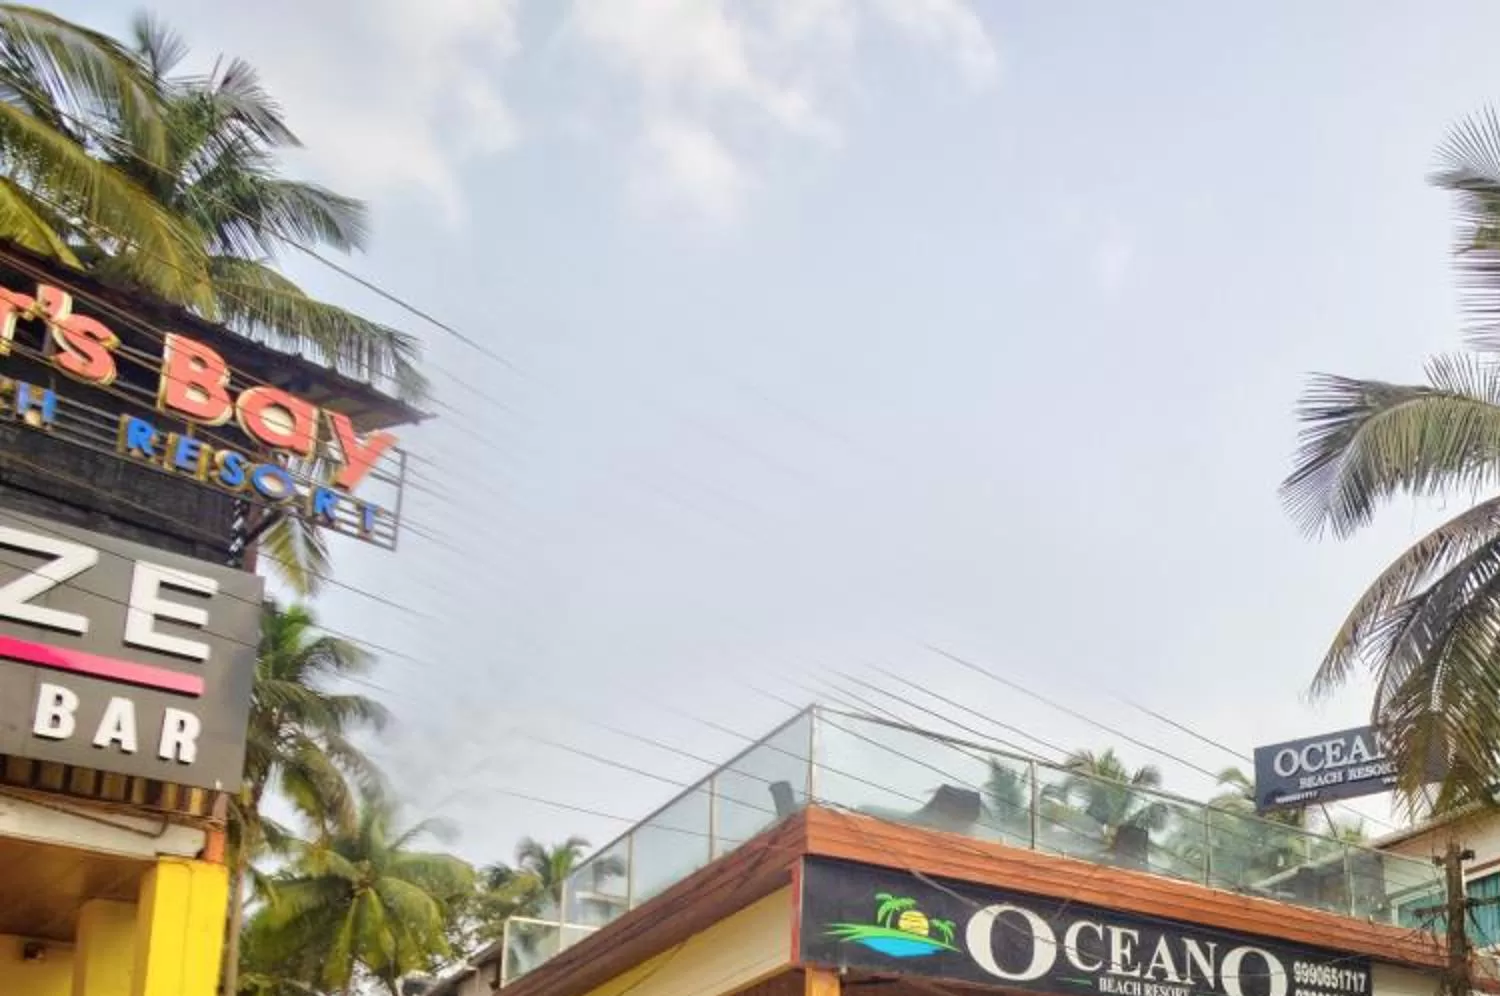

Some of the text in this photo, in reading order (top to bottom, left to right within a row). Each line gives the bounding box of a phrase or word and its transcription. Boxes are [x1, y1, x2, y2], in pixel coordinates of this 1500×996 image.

[158, 332, 398, 491] Bay
[0, 376, 385, 534] H RESORT
[32, 684, 201, 764] BAR
[1299, 770, 1343, 789] BEACH
[1099, 977, 1141, 996] BEACH
